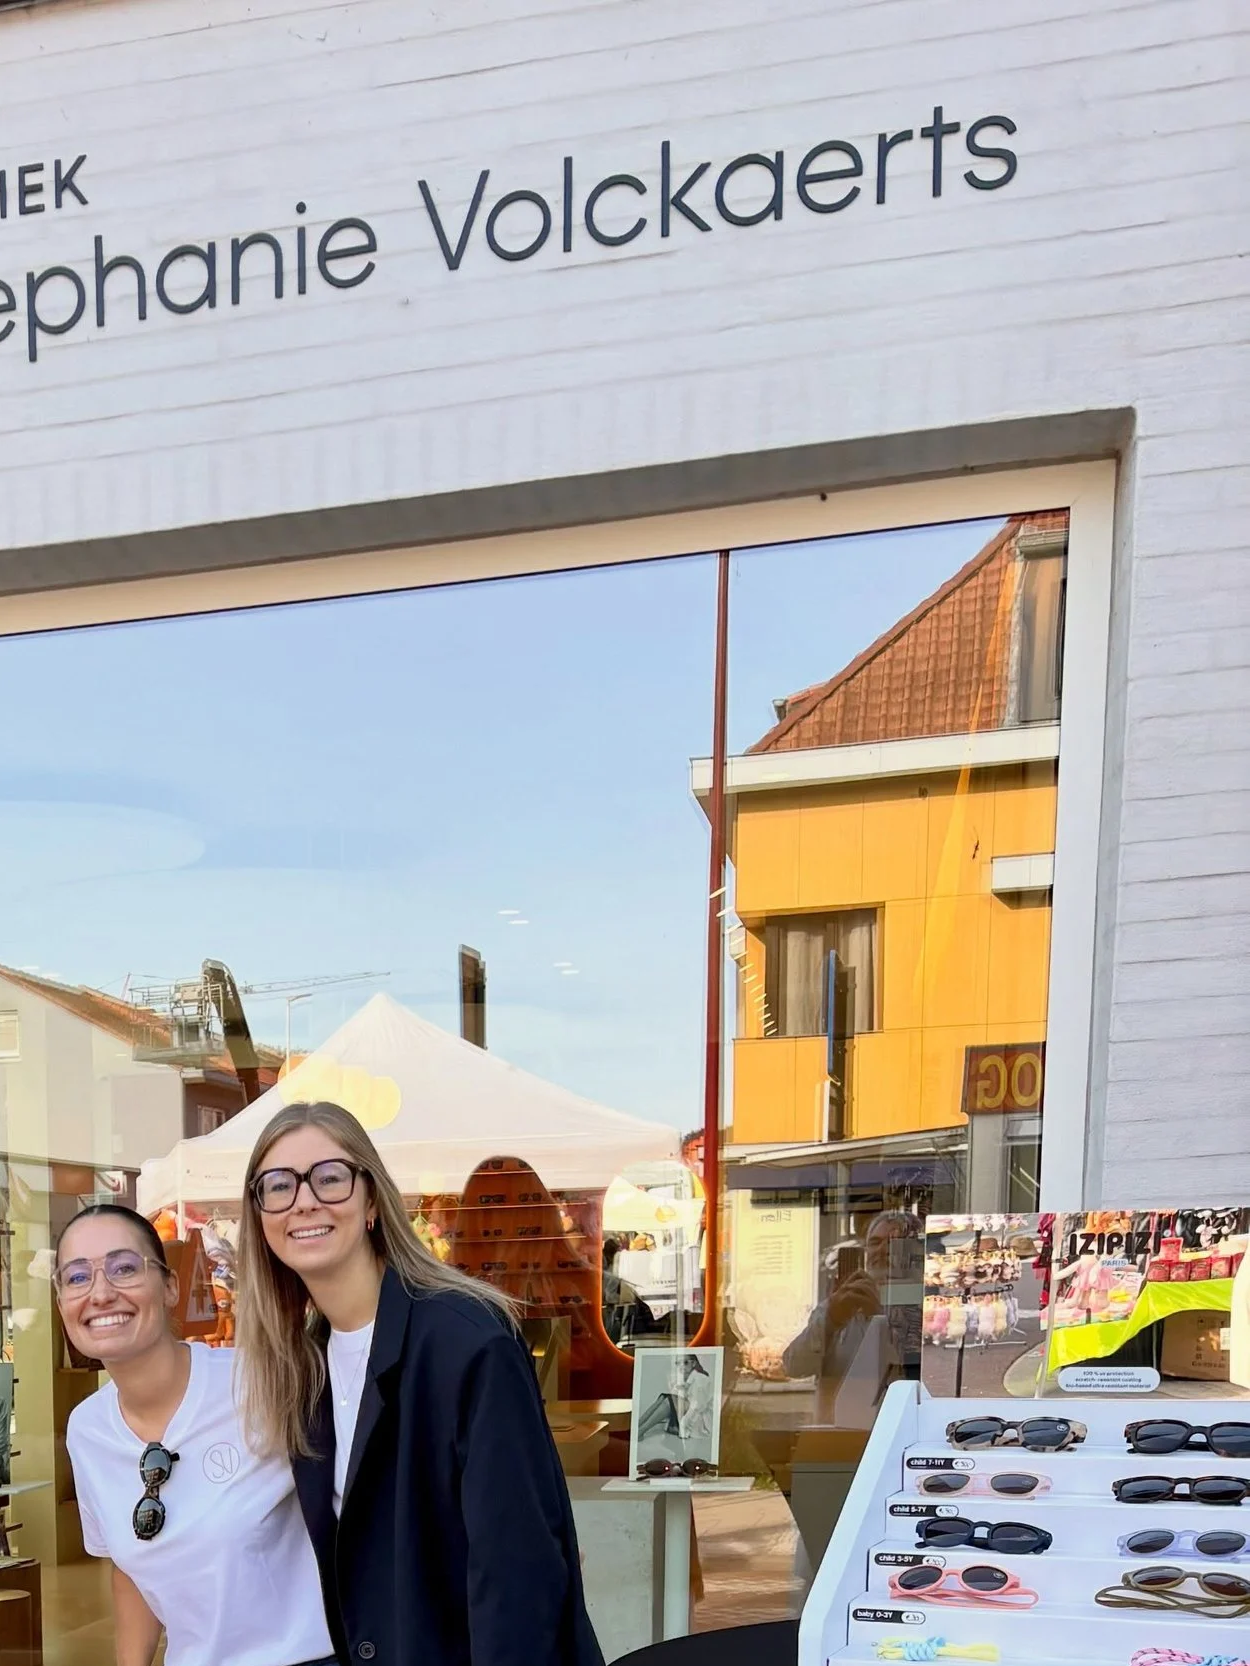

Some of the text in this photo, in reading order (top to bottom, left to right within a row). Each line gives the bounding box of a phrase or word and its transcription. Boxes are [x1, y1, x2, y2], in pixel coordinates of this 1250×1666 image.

[417, 105, 1018, 271] Volckaerts
[1068, 1231, 1161, 1256] IZIPIZI
[857, 1610, 874, 1619] baby
